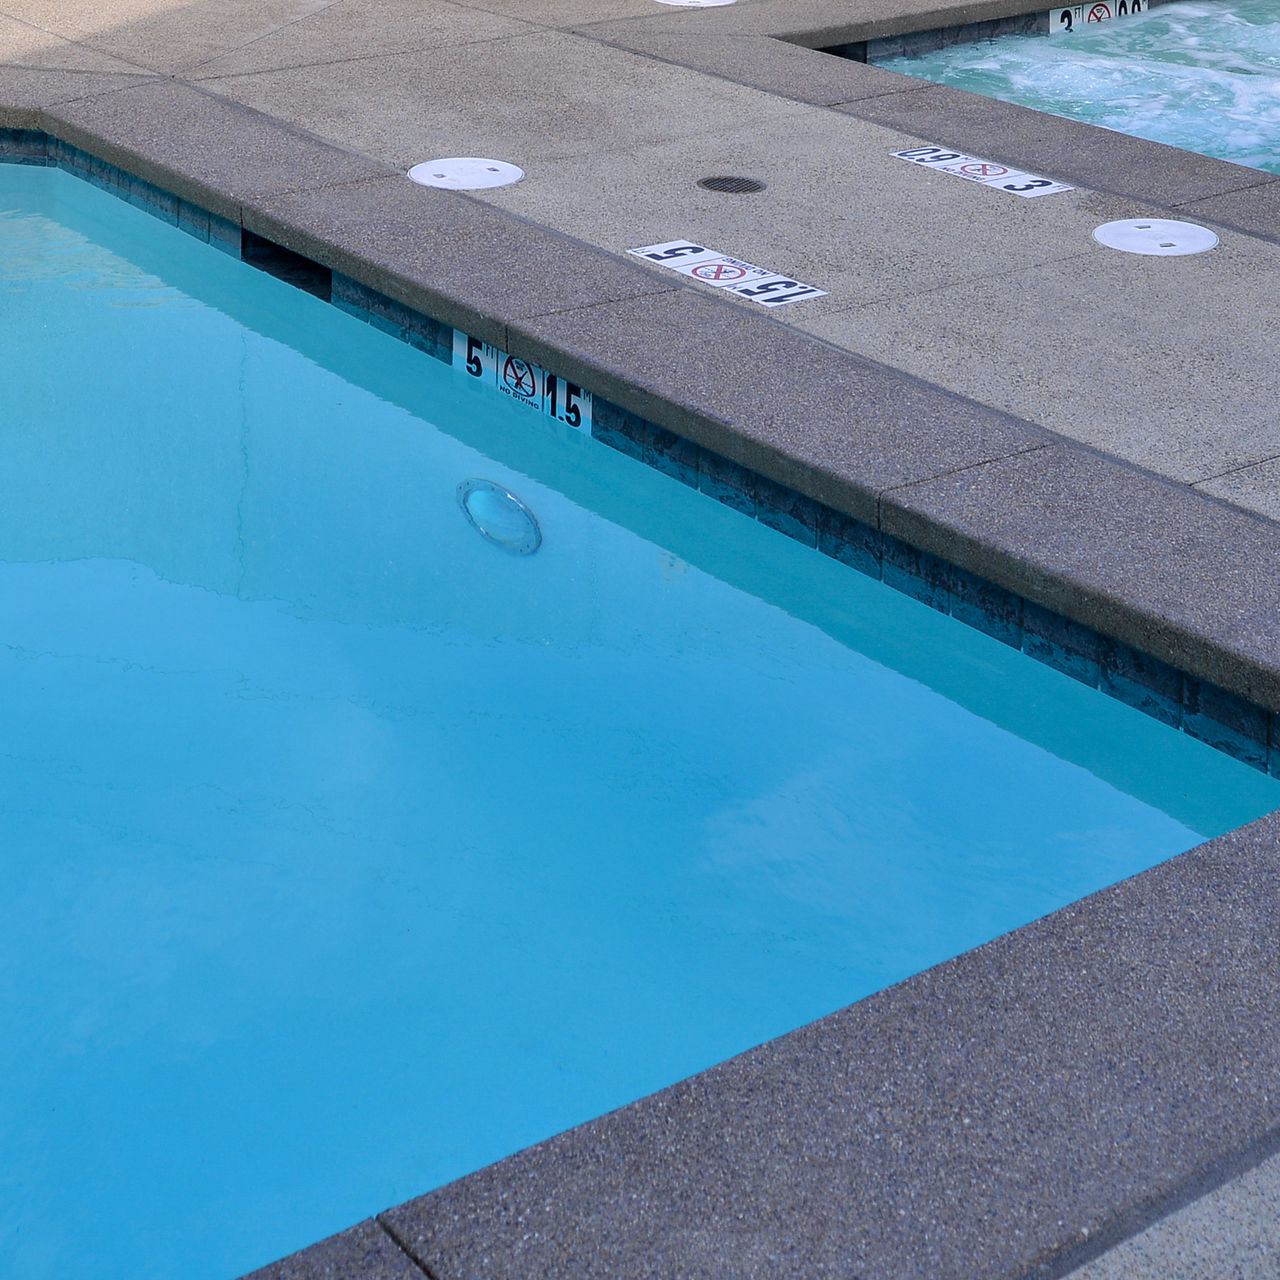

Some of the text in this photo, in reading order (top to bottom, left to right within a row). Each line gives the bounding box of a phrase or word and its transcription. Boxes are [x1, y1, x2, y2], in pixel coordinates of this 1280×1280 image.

[897, 147, 961, 163] 0.9
[1003, 179, 1053, 191] 3
[646, 246, 705, 261] 5
[737, 280, 817, 303] 1.5
[466, 336, 483, 377] 5
[499, 384, 540, 410] NO DIVING
[546, 374, 582, 428] 1.5
